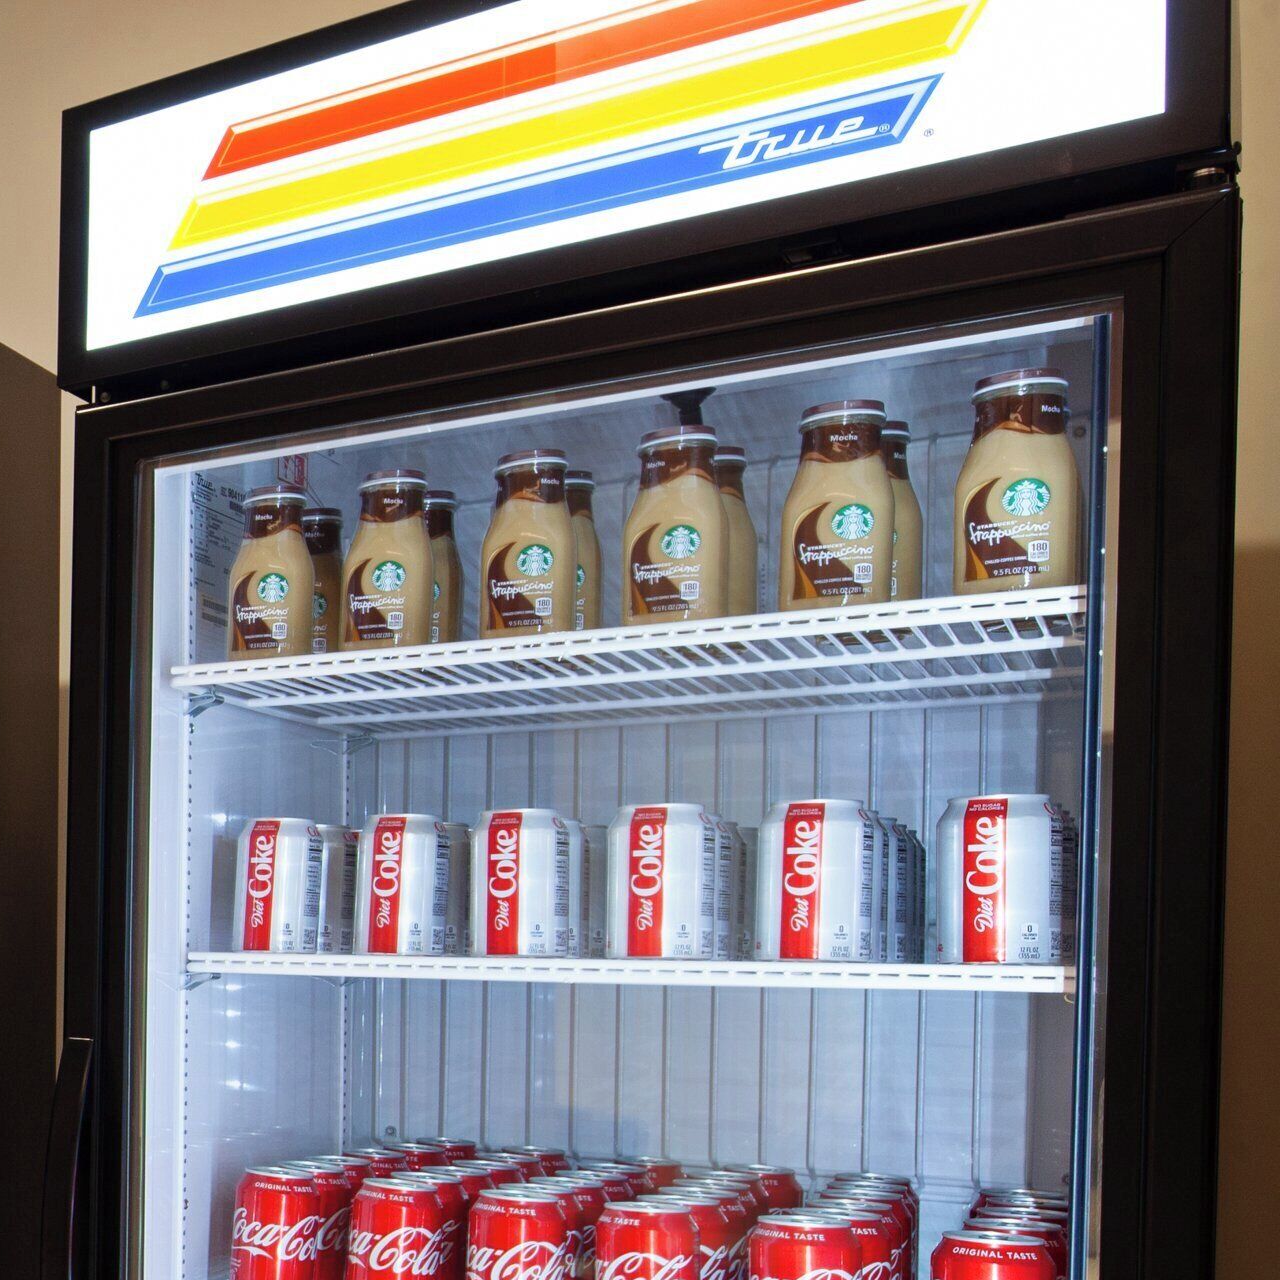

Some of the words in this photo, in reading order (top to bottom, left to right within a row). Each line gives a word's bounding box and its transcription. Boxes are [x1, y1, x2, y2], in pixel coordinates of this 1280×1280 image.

[274, 624, 286, 632] 180
[249, 835, 275, 898] Coke
[373, 831, 401, 898] Coke
[491, 825, 518, 899] Coke
[631, 824, 662, 897] Coke
[785, 820, 820, 896] Coke
[966, 816, 1003, 896] Coke
[251, 898, 266, 928] Diet
[255, 1181, 290, 1192] ORIGINAL
[294, 1185, 313, 1193] TASTE
